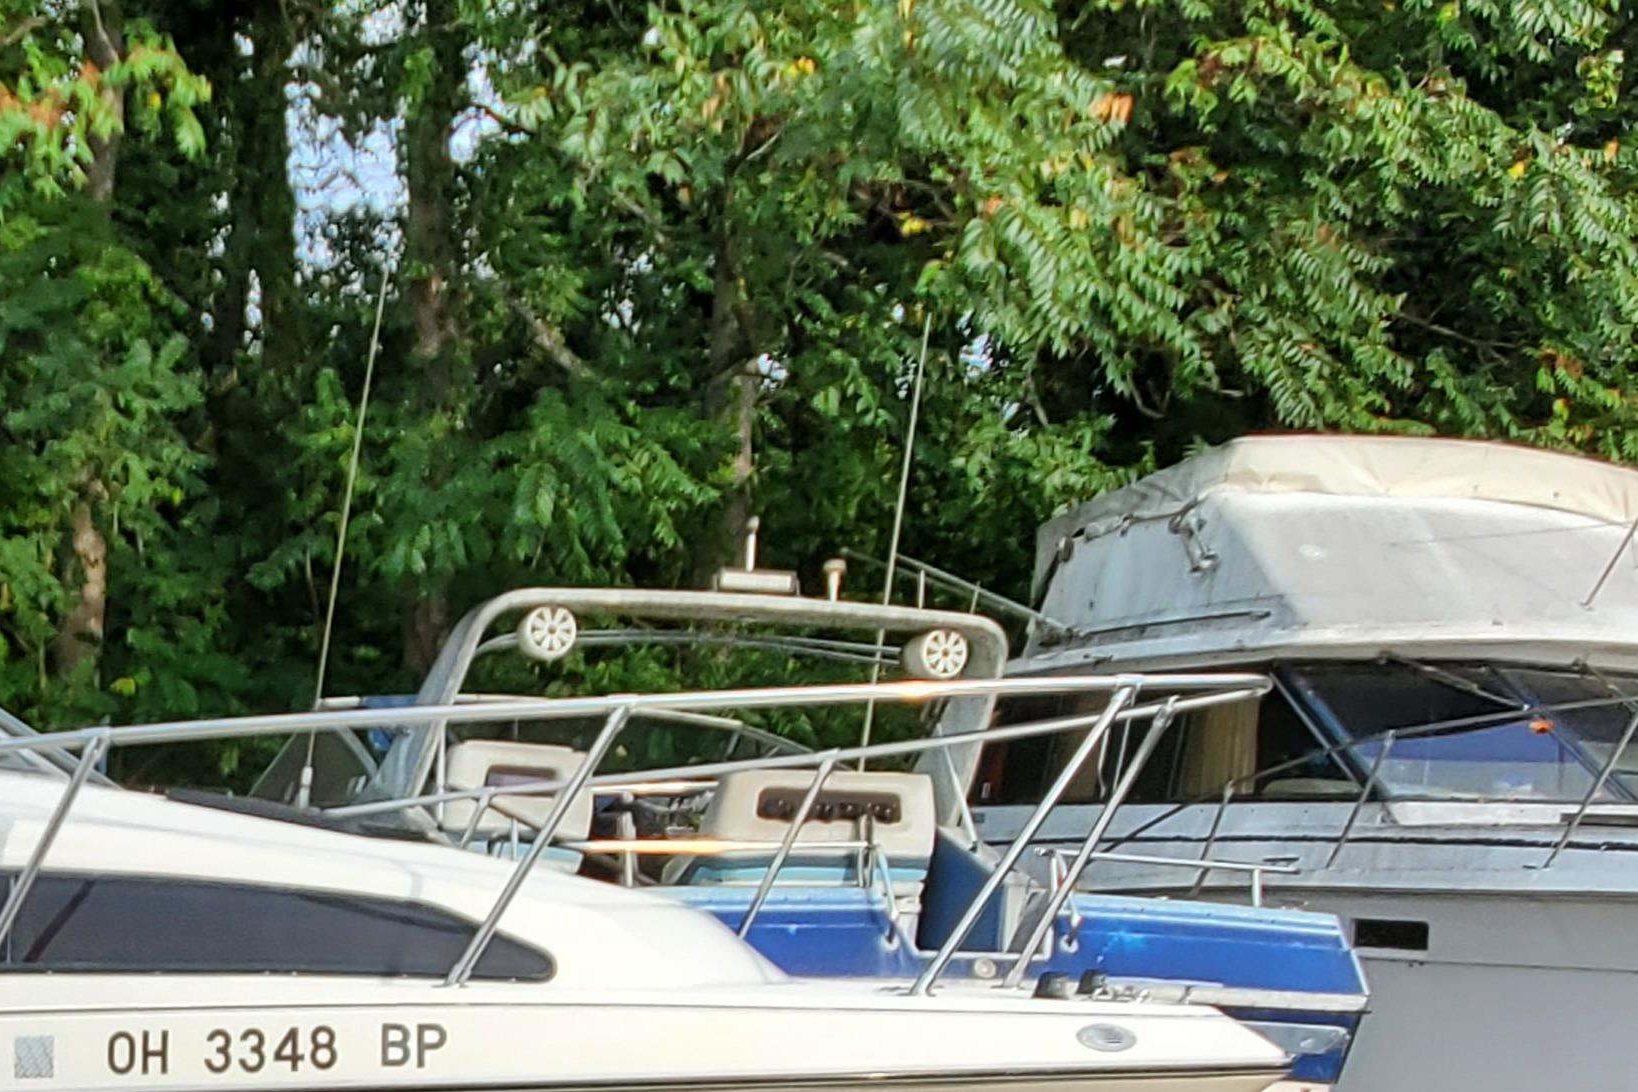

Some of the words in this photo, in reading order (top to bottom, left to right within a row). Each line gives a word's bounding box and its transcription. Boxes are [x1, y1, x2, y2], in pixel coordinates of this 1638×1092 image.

[107, 1029, 169, 1075] OH
[204, 1025, 339, 1073] 3348
[380, 1022, 448, 1068] BP
